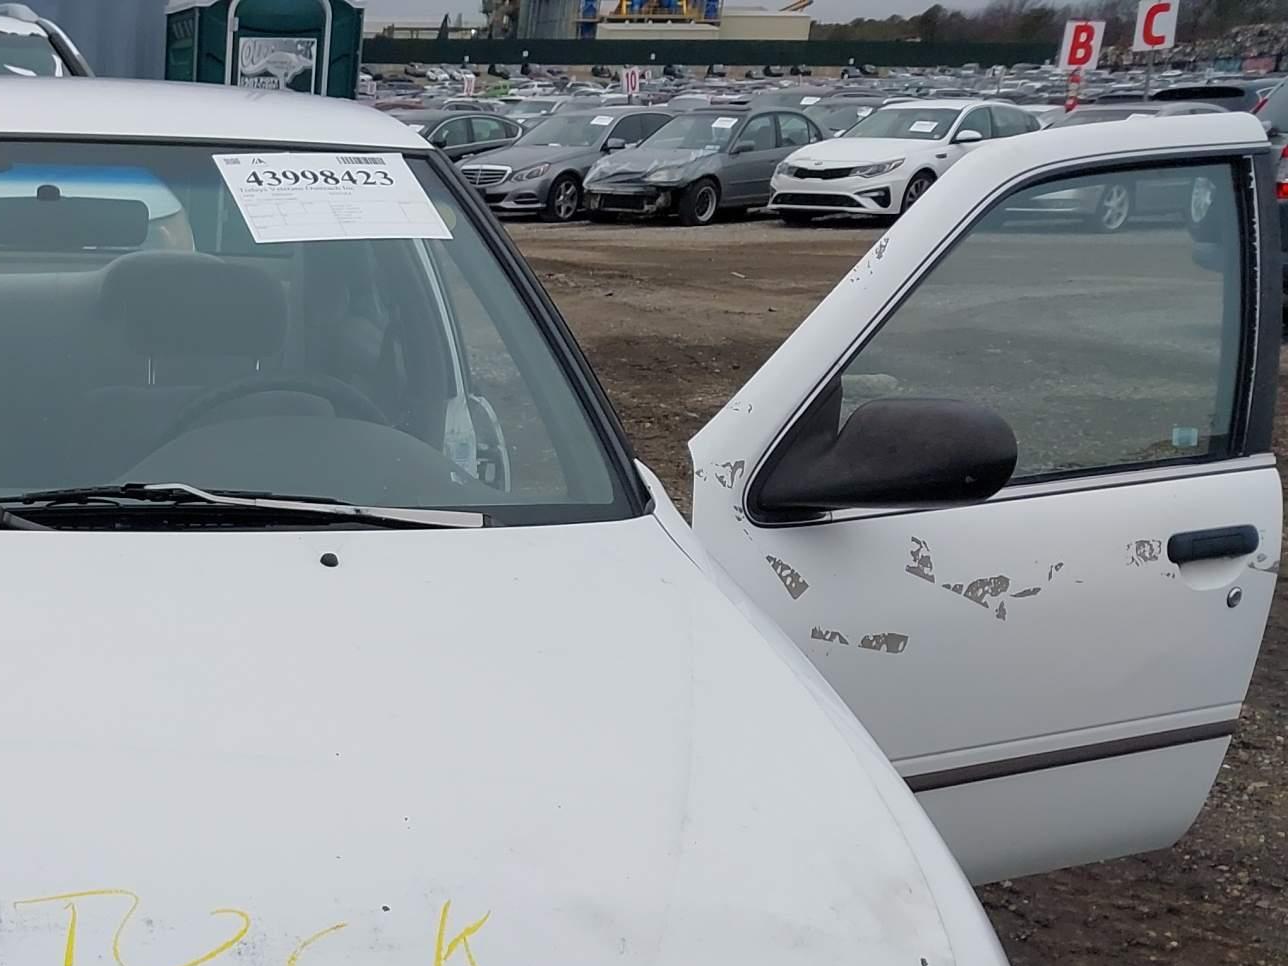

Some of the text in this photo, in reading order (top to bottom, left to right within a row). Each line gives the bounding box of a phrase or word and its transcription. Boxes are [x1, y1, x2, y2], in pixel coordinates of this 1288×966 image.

[1143, 3, 1171, 46] C
[1068, 24, 1095, 65] B
[625, 70, 637, 92] 10
[246, 170, 394, 187] 43998423
